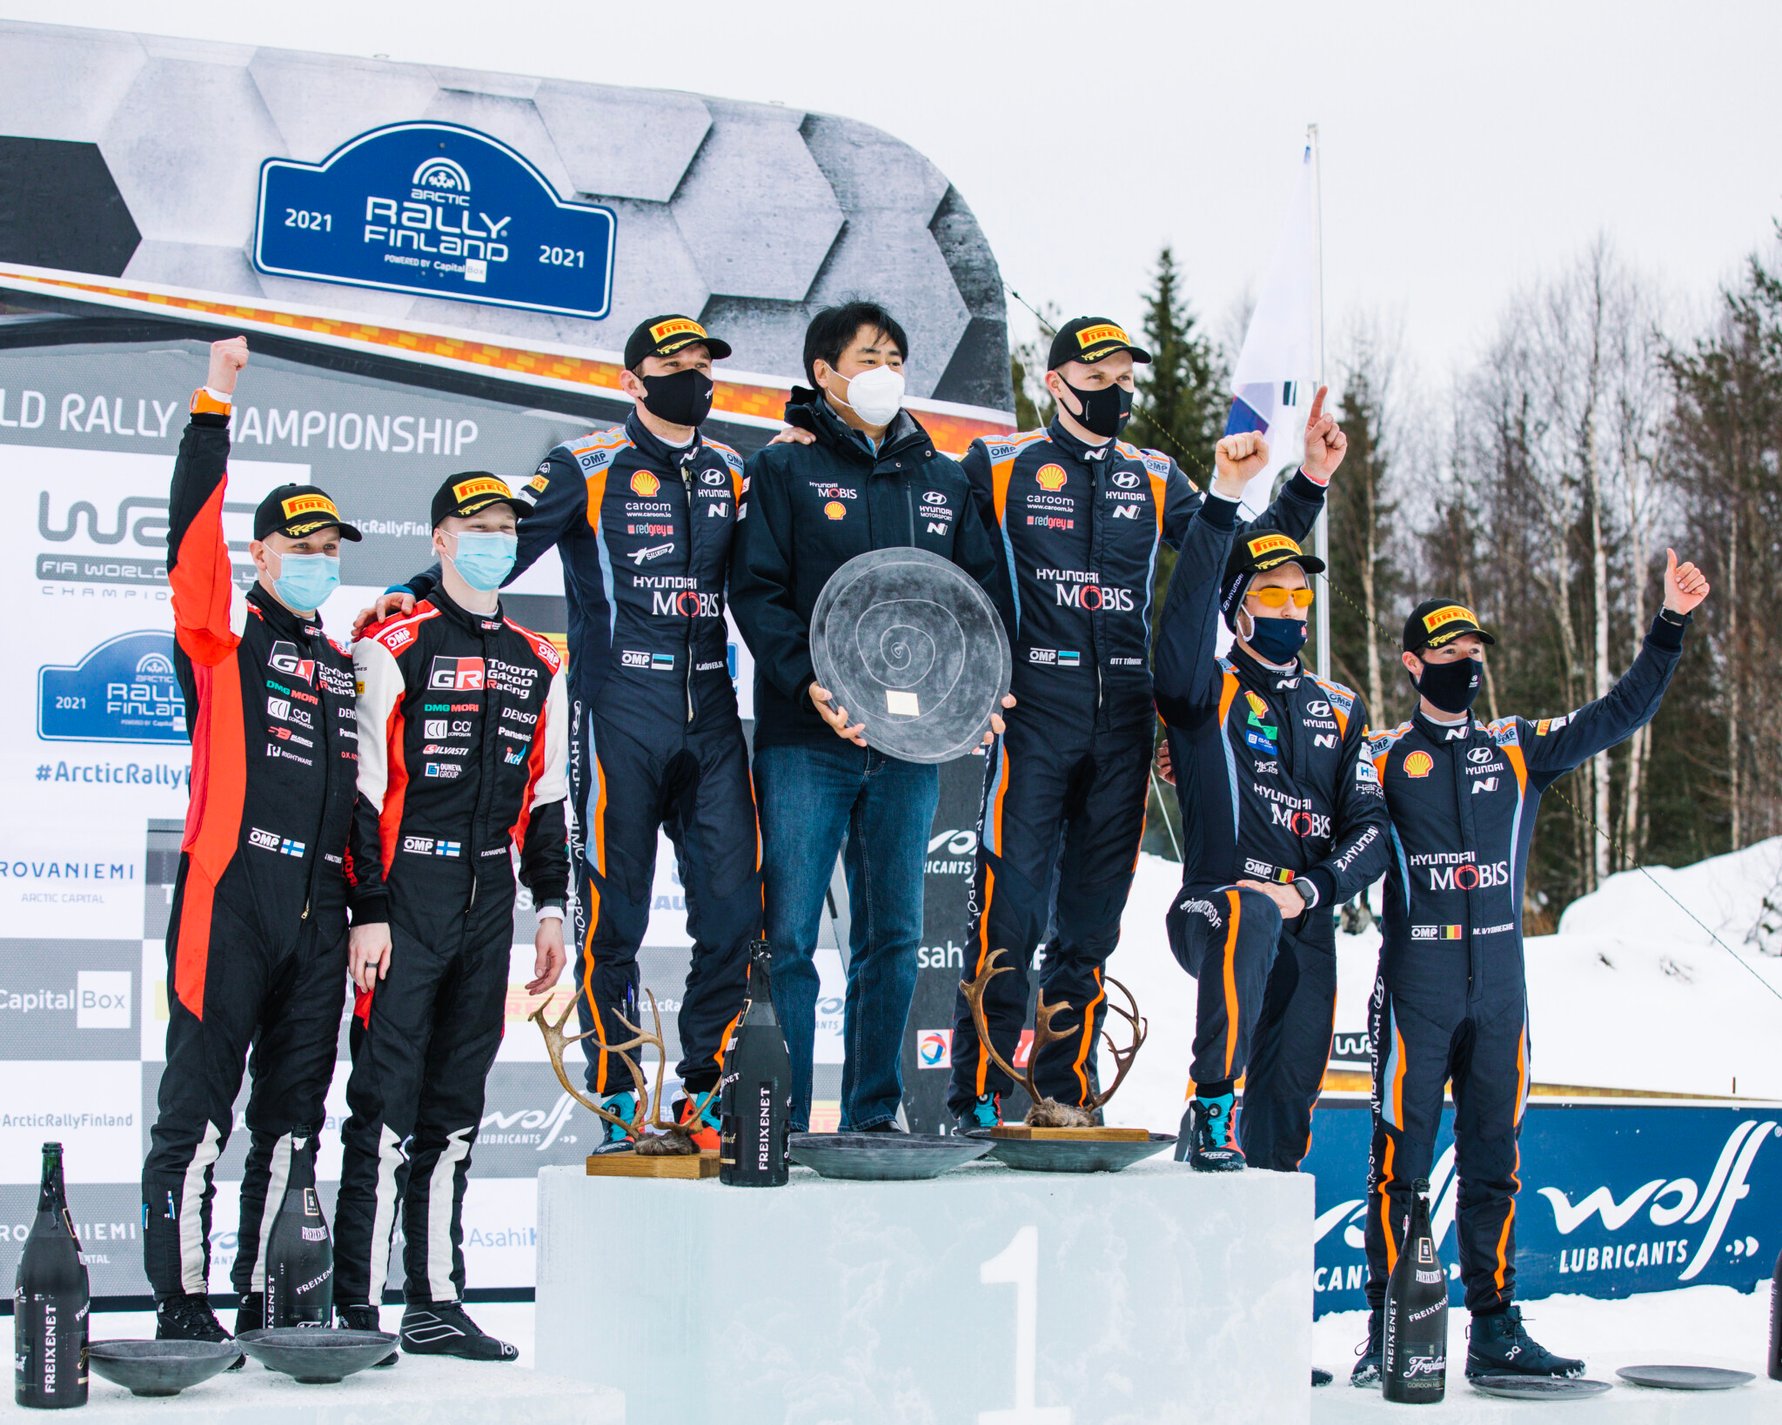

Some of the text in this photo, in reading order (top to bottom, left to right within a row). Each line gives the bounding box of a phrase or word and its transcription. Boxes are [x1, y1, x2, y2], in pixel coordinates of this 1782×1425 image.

[411, 188, 470, 206] ARCTIC
[285, 208, 332, 232] 2021
[384, 254, 420, 267] POWERED
[421, 259, 431, 268] BY
[538, 245, 585, 268] 2021
[59, 393, 178, 437] RALLY
[229, 405, 478, 455] HAMPIONSHIP
[991, 446, 1016, 456] OMP
[582, 453, 606, 466] OMP
[698, 489, 731, 499] HYUNDAI
[818, 488, 858, 499] MOBIS
[1027, 495, 1074, 506] caroom
[1105, 491, 1146, 501] HYUNDAI
[625, 502, 671, 512] caroom
[636, 524, 666, 537] redgrey
[1035, 516, 1067, 531] redgrey
[42, 560, 78, 574] FIA
[633, 576, 697, 589] HYUNDAI
[1036, 568, 1099, 584] HYUNDAI
[1056, 583, 1134, 611] MOBIS
[652, 592, 719, 618] MOBIS
[386, 631, 411, 647] OMP
[538, 645, 559, 664] OMP
[622, 653, 650, 665] OMP
[1030, 651, 1056, 663] OMP
[487, 658, 538, 678] TOYOTA
[432, 670, 483, 689] GR
[487, 670, 533, 687] GAZOO
[107, 683, 185, 702] RALL
[266, 680, 318, 705] DMG MORI
[487, 680, 530, 700] Racing
[55, 696, 86, 709] 2021
[424, 704, 479, 712] DMG MORI
[1329, 693, 1352, 708] OMP
[107, 701, 185, 716] FINLAN
[502, 707, 538, 725] DENSO
[293, 709, 311, 724] CCI
[452, 721, 472, 731] CCI
[423, 744, 469, 756] SILVASTI
[1253, 783, 1312, 810] HYUNDAI
[1271, 803, 1331, 838] MOBIS
[250, 831, 279, 848] OMP
[404, 839, 433, 852] OMP
[1410, 851, 1476, 866] HYUNDAI
[1245, 861, 1272, 875] OMP
[1429, 861, 1508, 891] MOBIS
[21, 892, 105, 904] ARCTIC CAPITAL
[1411, 928, 1438, 938] OMP
[759, 1087, 771, 1171] FREIXENET
[476, 1134, 541, 1144] LUBRICANTS
[1559, 1239, 1688, 1273] LUBRICANTS
[978, 1225, 1070, 1425] 1
[1387, 1298, 1398, 1373] FREIXENET
[44, 1304, 57, 1393] FREIXENET
